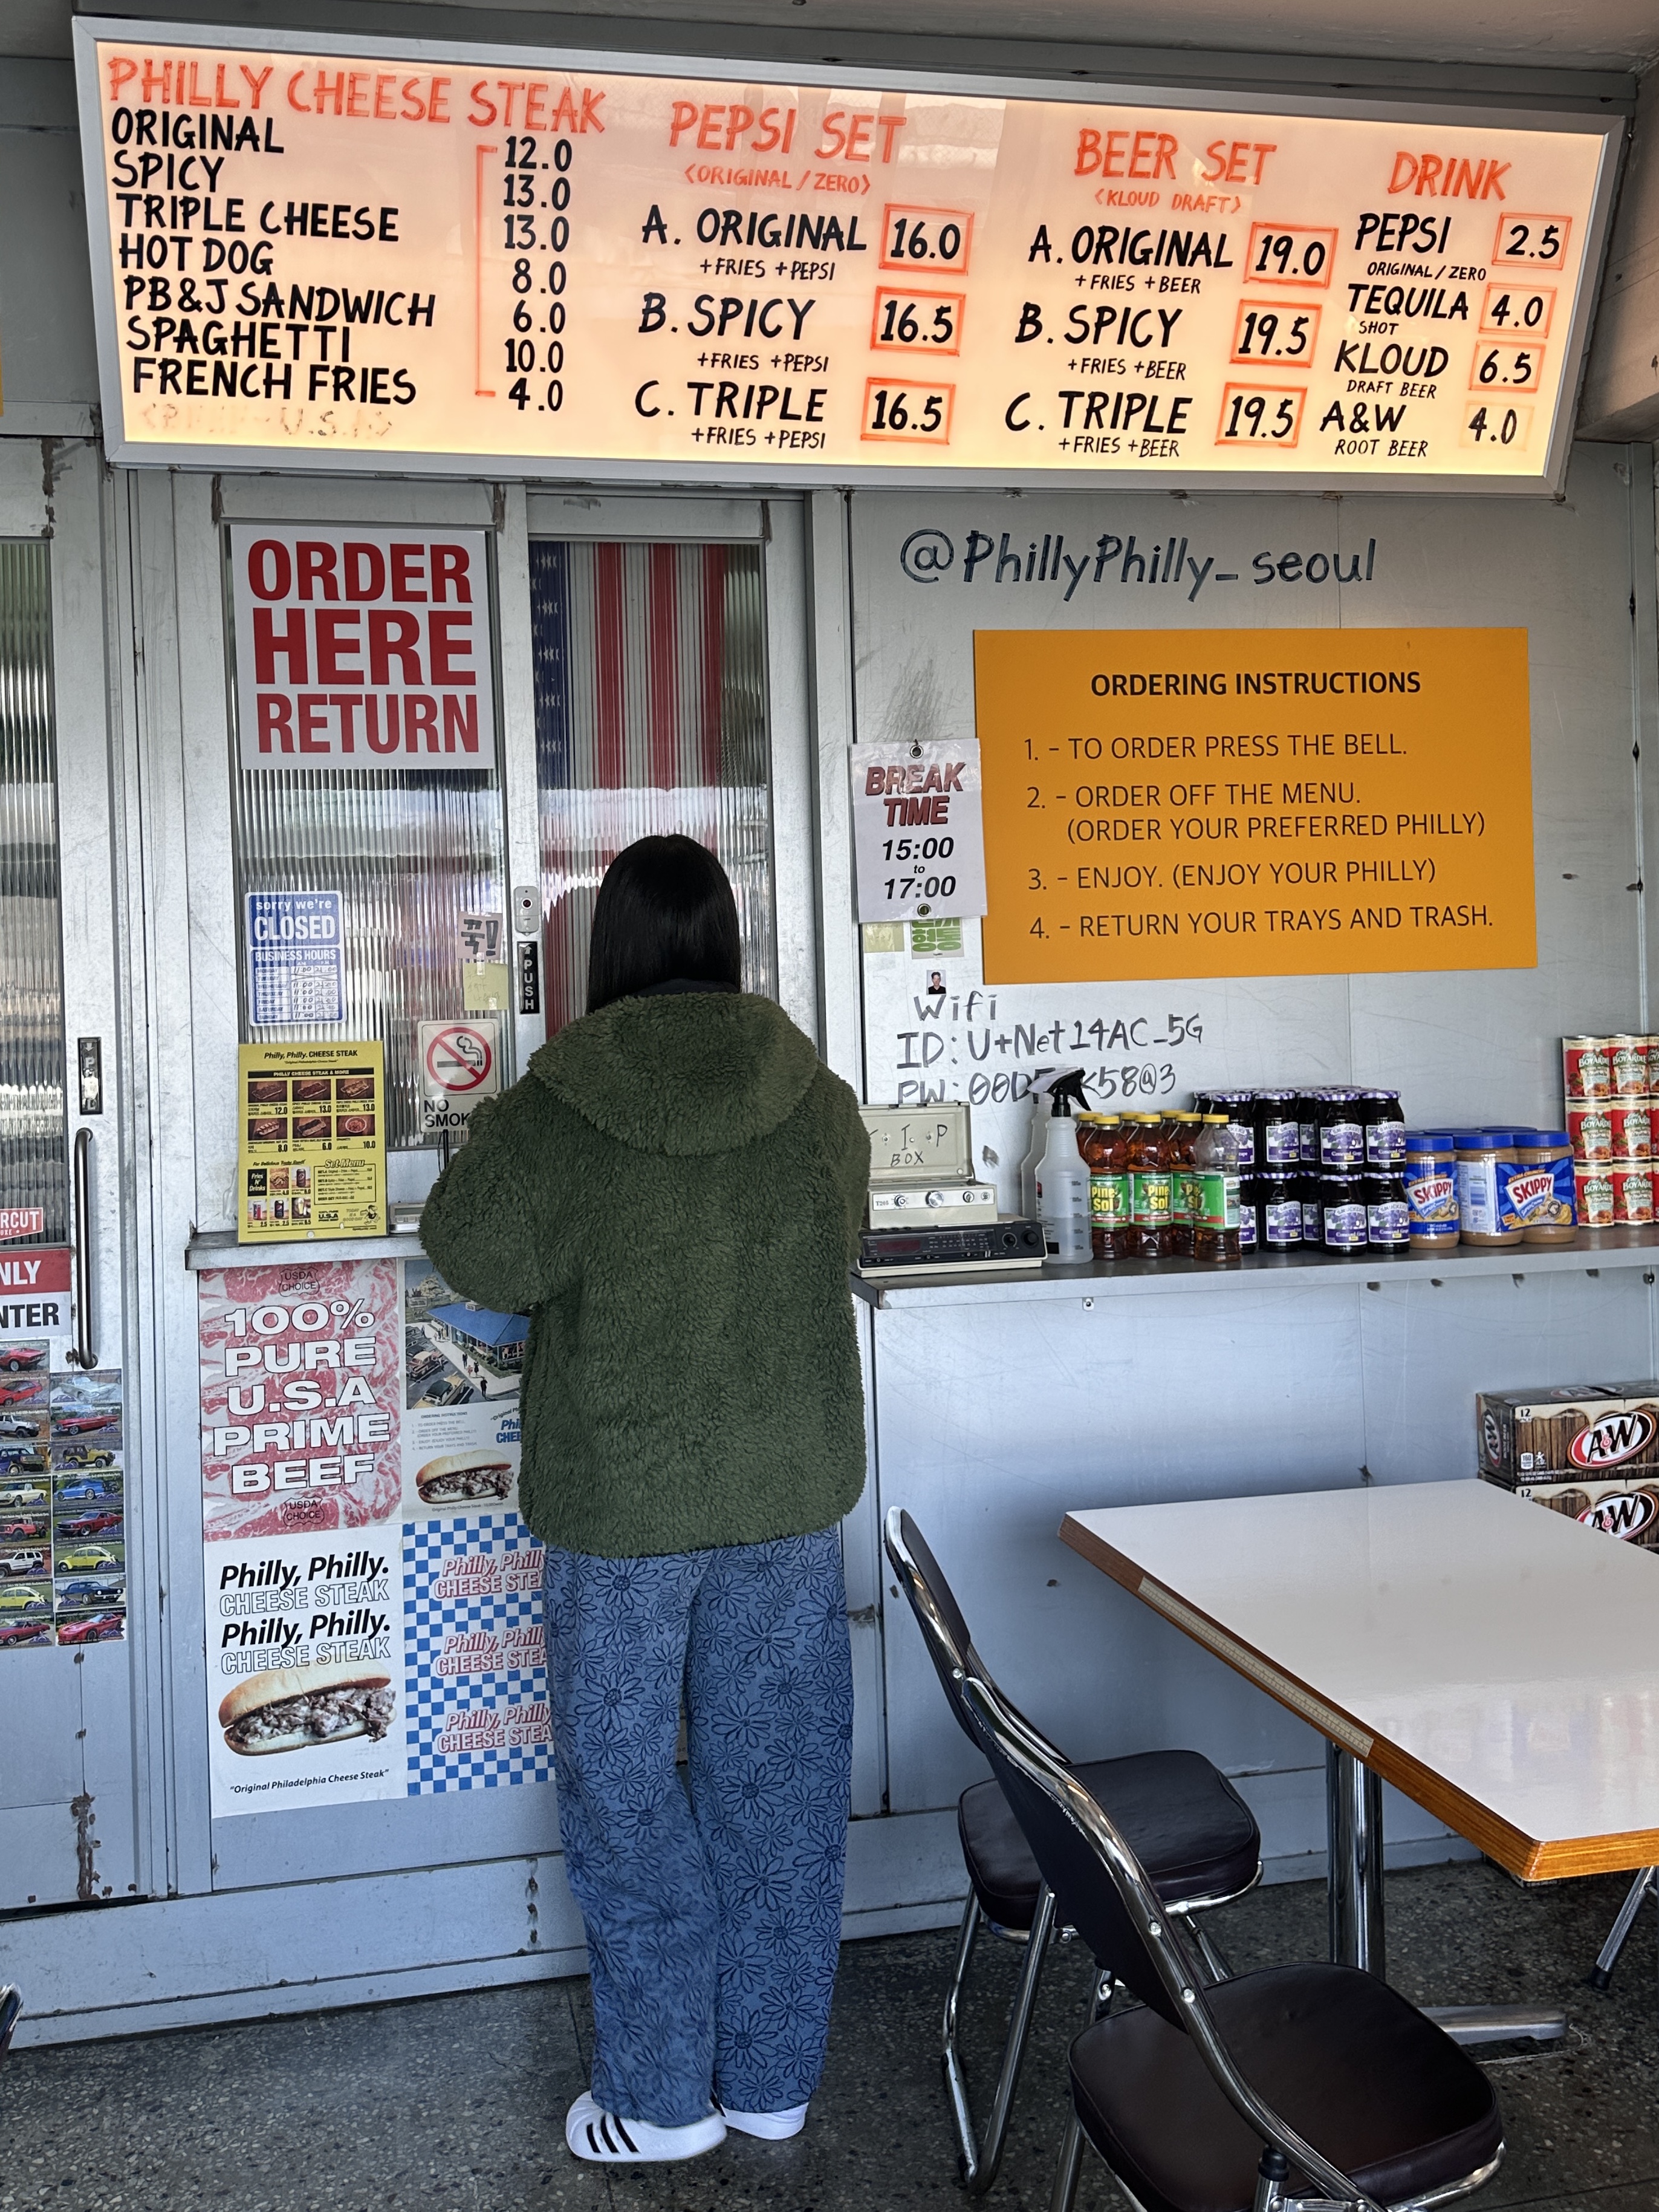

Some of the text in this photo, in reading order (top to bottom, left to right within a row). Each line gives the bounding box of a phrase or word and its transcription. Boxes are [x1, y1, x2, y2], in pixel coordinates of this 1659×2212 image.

[106, 57, 607, 134] PHILLY CHEESE STEAK
[111, 108, 285, 155] ORIGINAL
[669, 100, 907, 164] PEPSI SET
[111, 149, 224, 194] SPICY
[504, 135, 573, 173] 12.0
[1074, 128, 1278, 186] BEER SET
[504, 174, 571, 212] 13.0
[1386, 151, 1513, 201] DRINK
[115, 193, 400, 243] TRIPLE CHEESE
[504, 215, 570, 253] 13.0
[696, 207, 867, 252] ORIGINAL
[1354, 212, 1452, 255] PEPSI
[118, 233, 274, 277] HOT DOG
[889, 218, 961, 261] 16.0
[1070, 224, 1235, 270] ORIGINAL
[1254, 235, 1326, 277] 19.0
[1505, 225, 1560, 260] 2.5
[512, 258, 567, 296] 8.0
[699, 258, 836, 281] +FRIES +PEPSI
[1144, 274, 1201, 295] +BEER
[123, 276, 435, 328] PB&J SANDWICH
[513, 301, 567, 334] 6.0
[686, 294, 816, 341] SPICY
[1347, 283, 1470, 322] TEQUILA
[1490, 295, 1544, 328] 4.0
[126, 316, 351, 363] SPAGHETTI
[880, 299, 954, 343] 16.5
[1063, 304, 1183, 350] SPICY
[1238, 313, 1309, 357] 19.5
[1358, 319, 1398, 337] SHOT
[504, 338, 564, 375] 10.0
[696, 353, 829, 372] +FRIES +PEPSI
[1067, 357, 1187, 382] +FRIES +BEER
[1334, 339, 1450, 379] KLOUD
[1478, 350, 1534, 385] 6.5
[132, 357, 417, 406] FRENCH FRIES
[508, 378, 564, 413] 4.0
[1347, 378, 1438, 401] DRAFT BEER
[686, 381, 828, 423] TRIPLE
[871, 389, 943, 432] 16.5
[1057, 389, 1193, 436] TRIPLE
[1224, 396, 1295, 440] 19.5
[1319, 400, 1408, 435] A&W
[690, 427, 826, 450] +FRIES +PEPSI
[1468, 406, 1519, 445] 4.0
[1057, 436, 1180, 460] +FRIES +BEER
[1334, 438, 1429, 460] ROOT BEER
[248, 539, 474, 603] ORDER
[252, 608, 477, 686] HERE
[1090, 671, 1422, 698] ORDERING INSTRUCTIONS
[256, 693, 479, 755] RETURN
[1068, 733, 1407, 762] TO ORDER PRESS THE BELL.
[865, 762, 966, 796] BREAK
[1075, 781, 1362, 809] ORDER OFF THE MENU.
[883, 795, 949, 827] TIME
[1066, 810, 1486, 846] (ORDER YOUR PREFERRED PHILLY)
[883, 837, 954, 861] 15:00
[885, 876, 956, 900] 17:00
[914, 865, 925, 874] to
[1077, 857, 1437, 890] ENJOY. (ENJOY YOUR PHILLY)
[256, 899, 332, 911] sorry we're
[1079, 904, 1494, 938] RETURN YOUR TRAYS AND TRASH.
[255, 916, 336, 940] CLOSED
[256, 950, 336, 961] BUSINESS HOURS
[524, 959, 534, 1010] PUSH
[424, 1099, 449, 1113] NO
[363, 1140, 375, 1149] 10.0
[891, 1151, 924, 1167] BOX
[1413, 1180, 1452, 1205] SKIPPY
[1511, 1176, 1553, 1204] SKIPPY
[282, 1281, 317, 1291] CHOICE
[284, 1271, 313, 1281] USDA
[224, 1298, 375, 1336] 100%
[225, 1336, 377, 1377] PURE
[227, 1376, 377, 1416] U.S.A
[1521, 1408, 1530, 1417] 12
[213, 1412, 391, 1457] PRIME
[1586, 1413, 1639, 1465] A&W
[231, 1454, 375, 1494] BEEF
[287, 1510, 321, 1521] CHOICE
[288, 1500, 318, 1509] USDA
[220, 1550, 389, 1590] Philly, Philly.
[442, 1553, 497, 1578] Philly,
[219, 1579, 389, 1616] CHEESE STEAK
[433, 1572, 502, 1599] CHEESE
[221, 1609, 391, 1648] Philly, Philly.
[221, 1637, 391, 1674] CHEESE STEAK
[437, 1728, 505, 1754] CHEESE
[271, 1772, 359, 1789] Philadelphia Cheese
